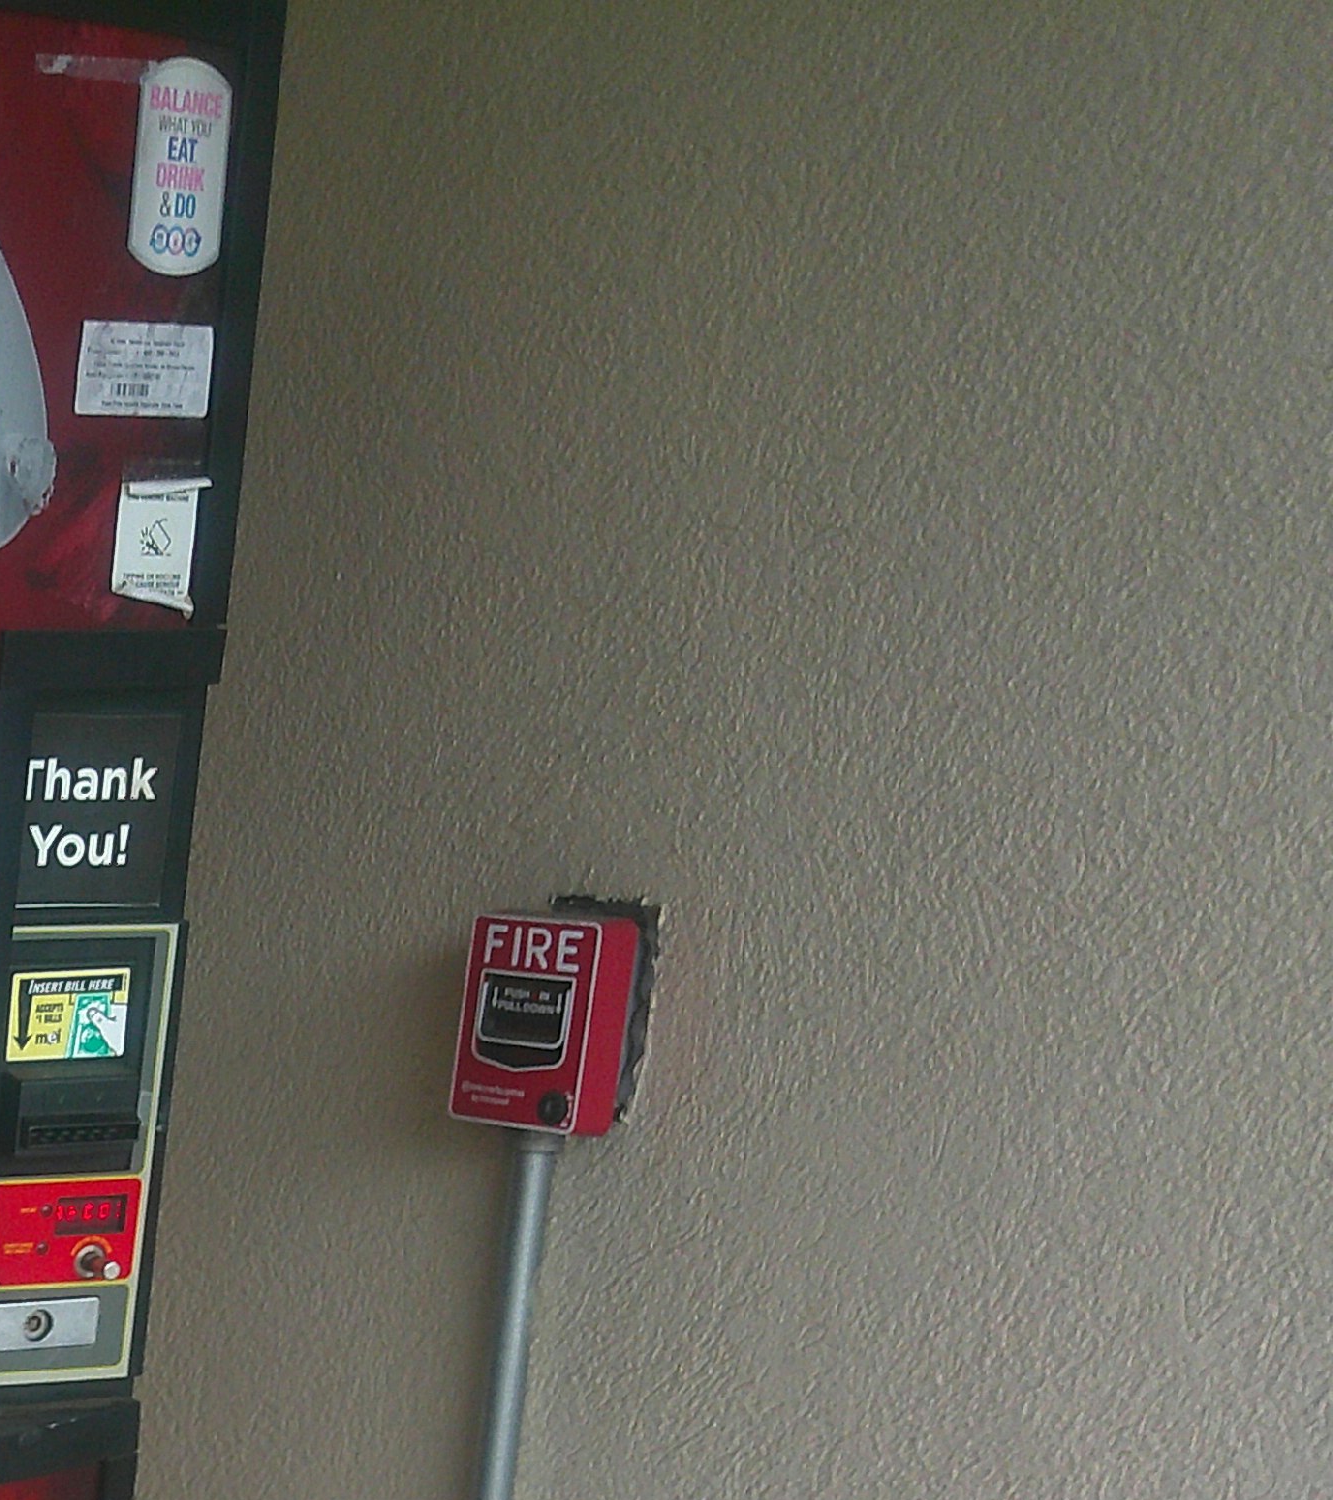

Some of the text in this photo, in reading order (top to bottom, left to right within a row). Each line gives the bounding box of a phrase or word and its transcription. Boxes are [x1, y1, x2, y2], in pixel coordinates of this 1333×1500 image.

[150, 83, 223, 118] BALANCE
[159, 115, 212, 137] WHAT YOU
[155, 163, 205, 191] DRINK
[159, 191, 197, 218] & DO
[25, 757, 158, 800] Thank
[29, 824, 130, 867] You!
[484, 924, 585, 973] FIRE
[27, 978, 115, 995] INSERT BILL HERE
